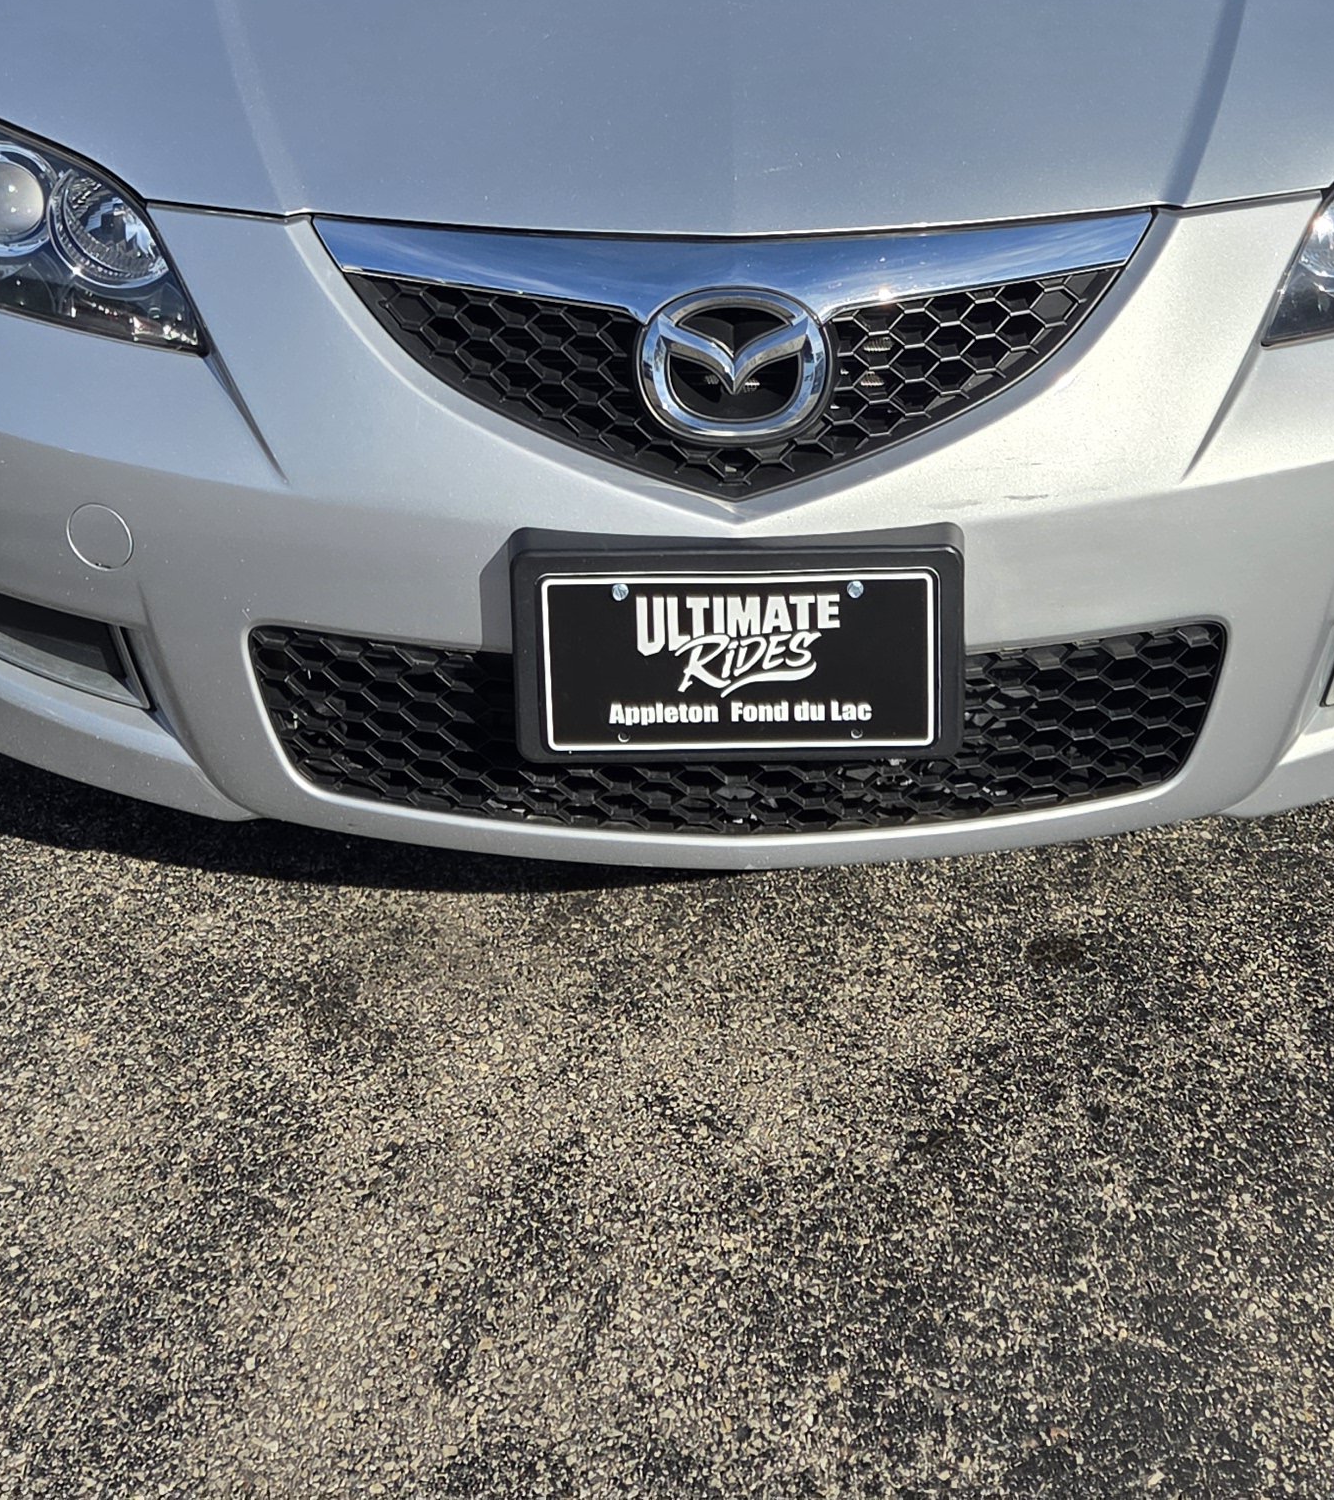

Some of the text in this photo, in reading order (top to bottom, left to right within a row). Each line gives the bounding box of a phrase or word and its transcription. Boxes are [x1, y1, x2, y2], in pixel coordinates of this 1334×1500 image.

[635, 592, 841, 657] ULTIMATE
[608, 700, 873, 726] Appleton Fond du Lac
